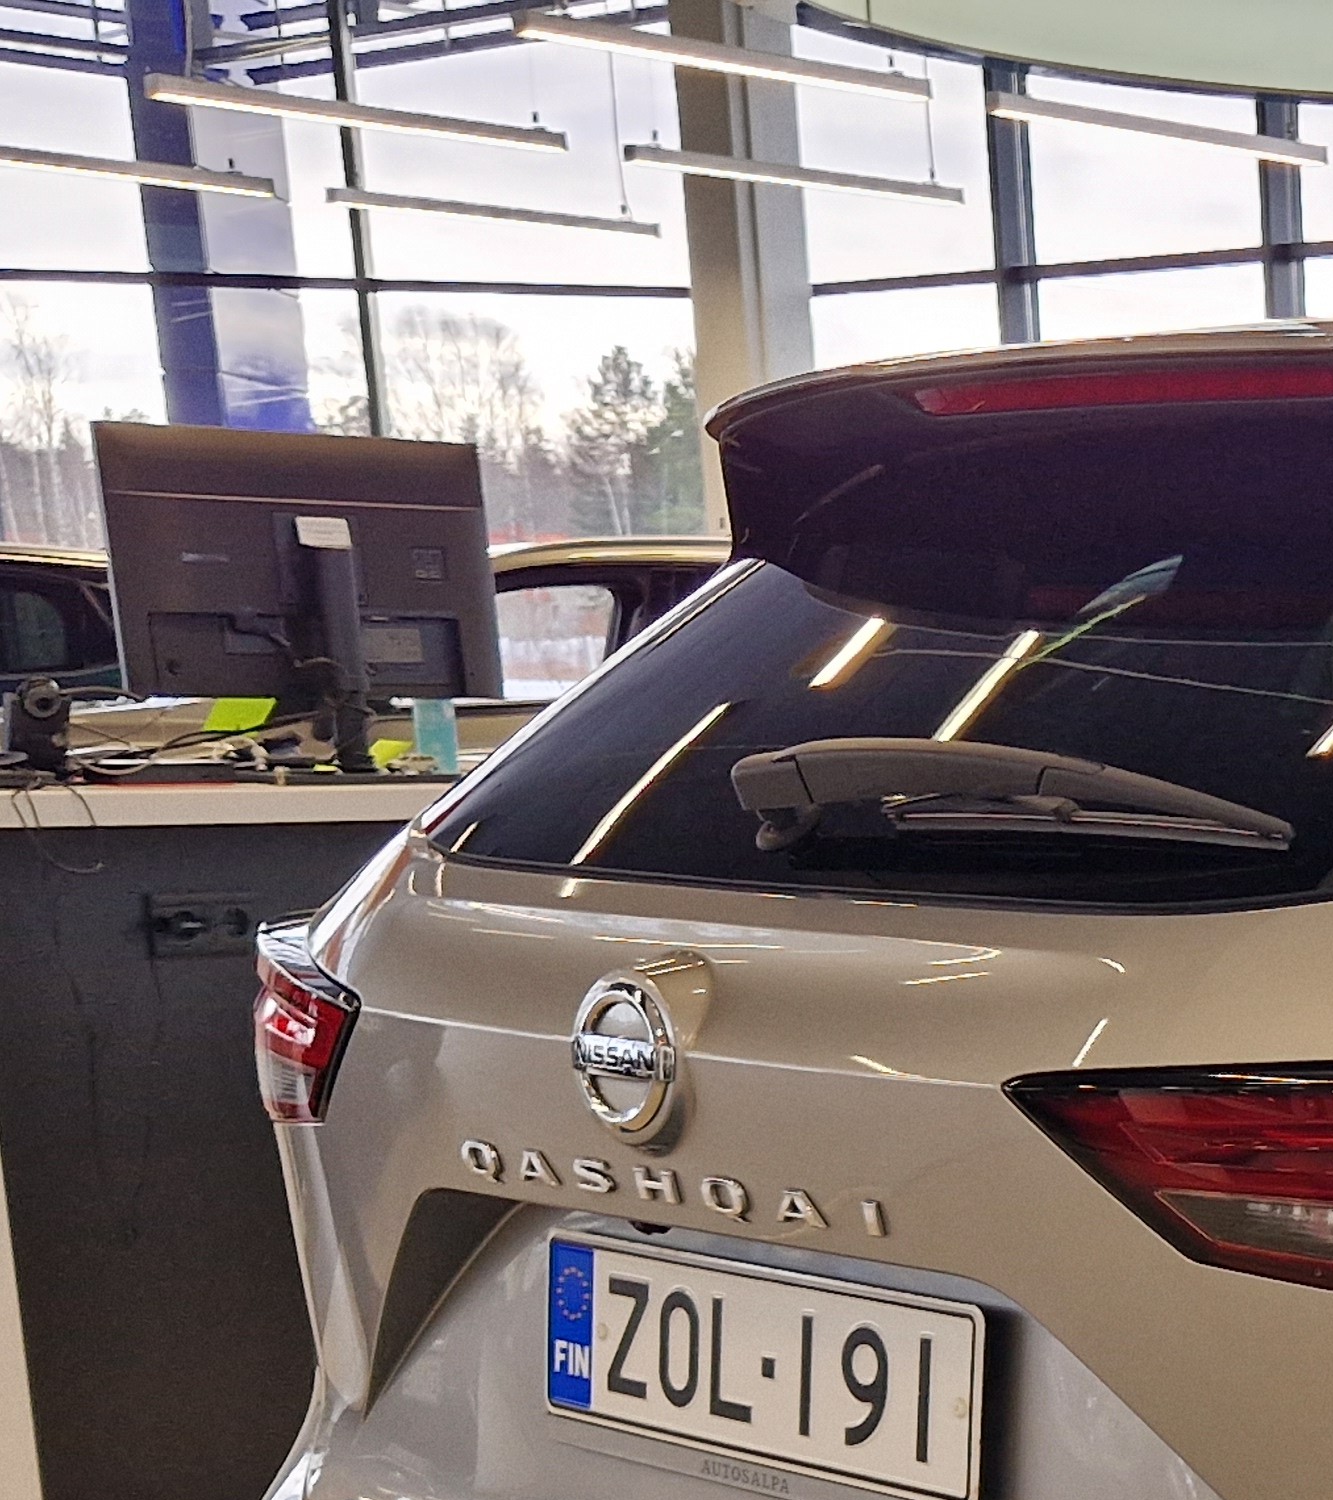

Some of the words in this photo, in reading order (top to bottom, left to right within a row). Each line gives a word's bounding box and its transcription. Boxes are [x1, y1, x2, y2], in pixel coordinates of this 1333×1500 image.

[577, 1037, 656, 1072] NISSAN
[460, 1138, 886, 1238] QASHQAI
[553, 1339, 591, 1380] FIN
[701, 1459, 790, 1495] AUTOSALPA
